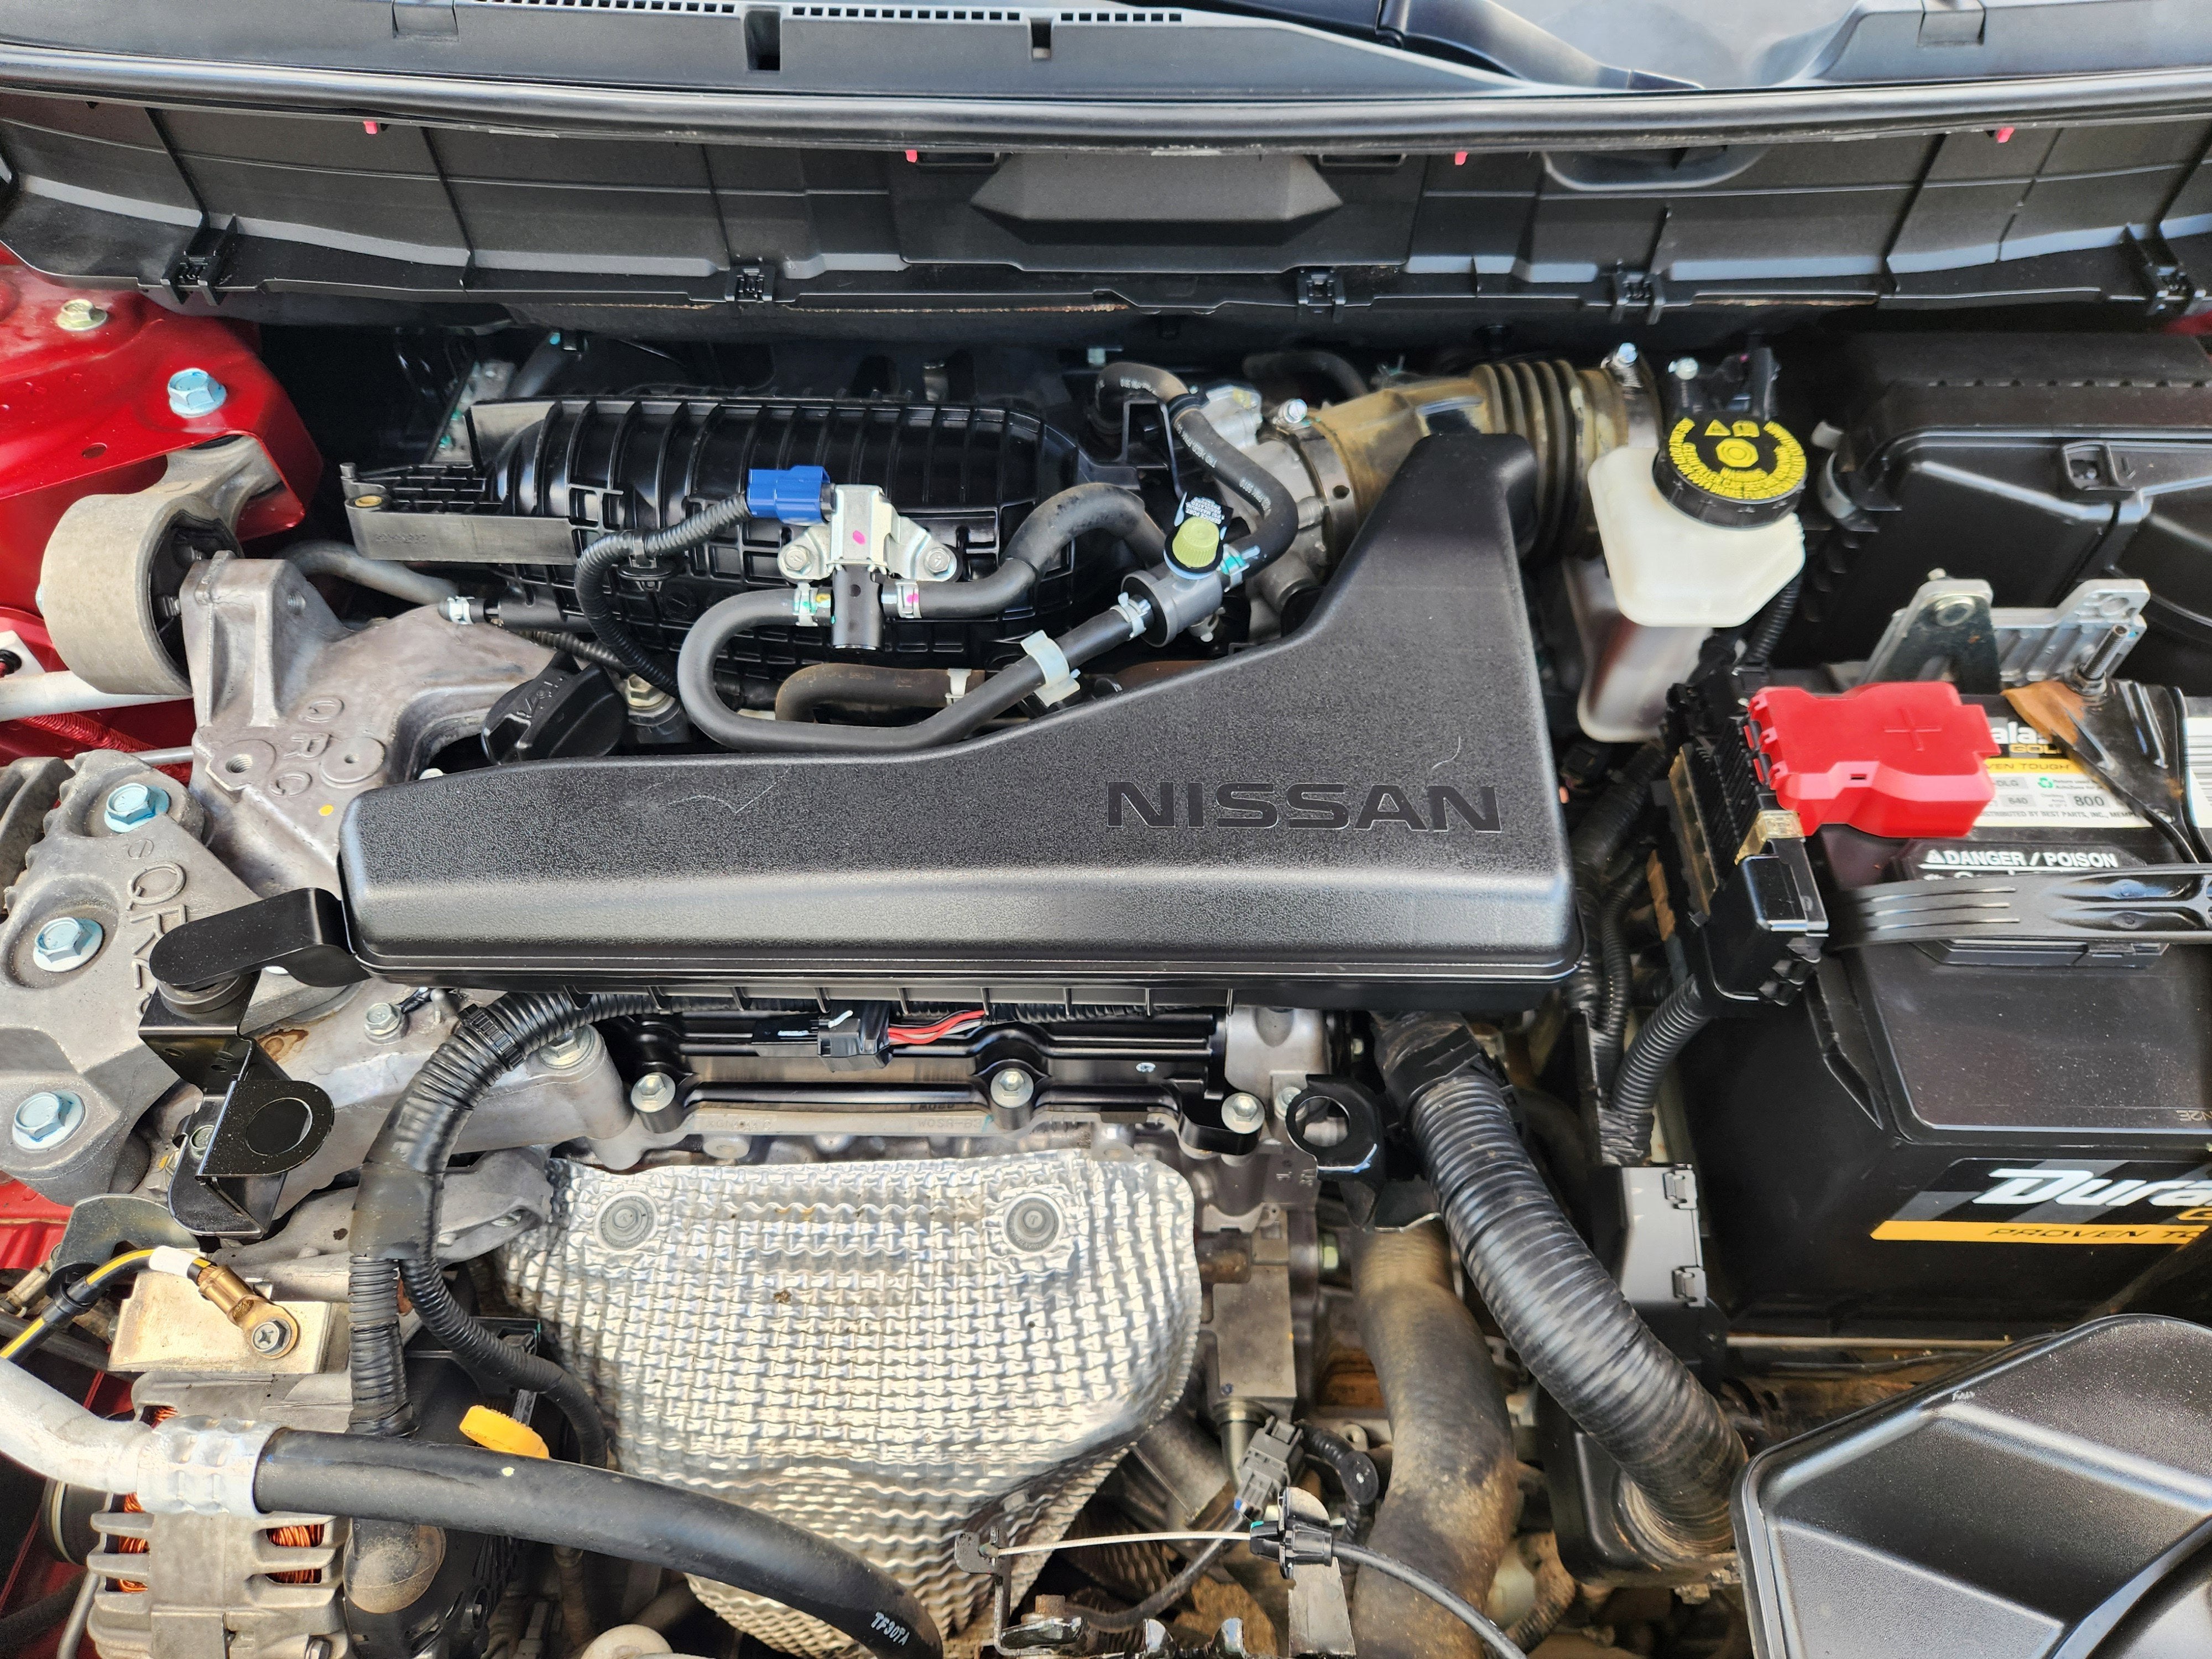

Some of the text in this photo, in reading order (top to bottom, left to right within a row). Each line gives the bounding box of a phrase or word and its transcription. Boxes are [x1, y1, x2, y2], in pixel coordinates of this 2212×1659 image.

[2008, 744, 2061, 754] GOL
[1107, 781, 1503, 833] NISSAN
[2073, 796, 2105, 807] 800
[1943, 849, 2119, 868] DANGER / POISON
[1972, 1168, 2212, 1207] Dura
[1987, 1228, 2149, 1238] PROVEN
